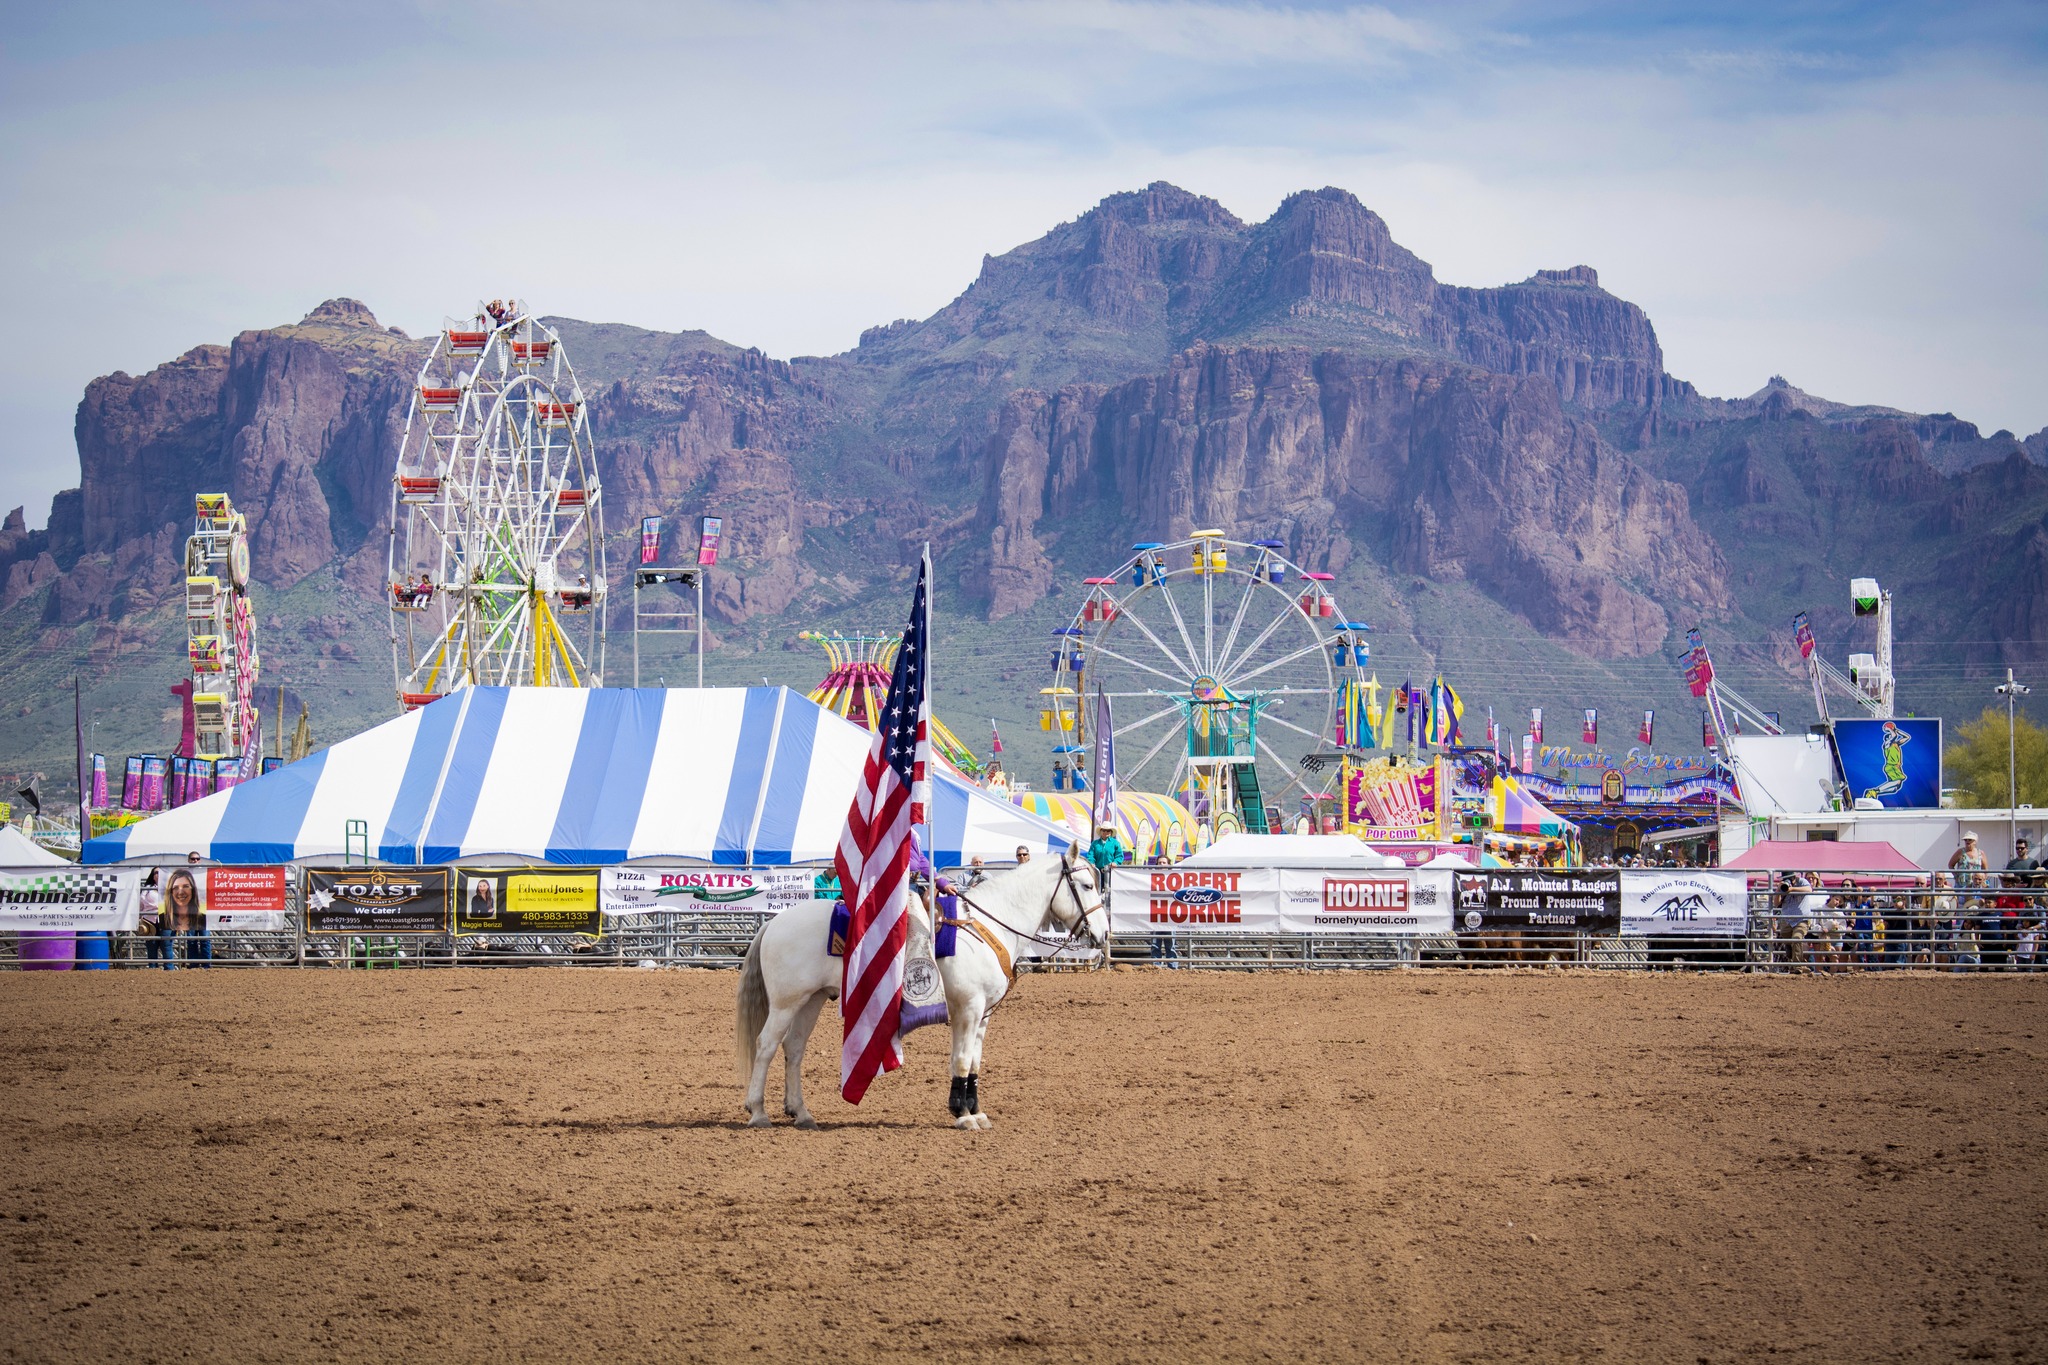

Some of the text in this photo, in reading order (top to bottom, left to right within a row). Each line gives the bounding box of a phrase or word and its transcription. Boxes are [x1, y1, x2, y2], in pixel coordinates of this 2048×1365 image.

[240, 740, 259, 779] LIGHT
[1539, 745, 1710, 776] Music Express
[1366, 828, 1418, 839] POP CORN
[215, 871, 228, 879] It's
[249, 871, 276, 879] future.
[660, 873, 753, 888] ROSATI'S
[235, 881, 264, 889] protect
[1150, 872, 1241, 892] ROBERT
[1490, 878, 1618, 894] A.J. Mounted Rangers
[333, 885, 422, 896] TOAST
[518, 884, 584, 894] Edward Jones
[1182, 888, 1214, 903] Ford
[1327, 883, 1405, 908] HORNE
[1640, 882, 1673, 904] Mountain
[1689, 880, 1717, 897] Electric
[605, 902, 658, 910] Entertainment
[723, 904, 753, 912] Canyon
[767, 902, 784, 910] Pool
[1546, 895, 1605, 911] Presenting
[522, 912, 589, 920] 480-983-1333
[1150, 900, 1241, 923] HORNE
[1666, 907, 1698, 921] MTE
[461, 921, 482, 929] Maggie
[1314, 915, 1418, 925] hornehyundai.com
[1528, 912, 1576, 925] Partners
